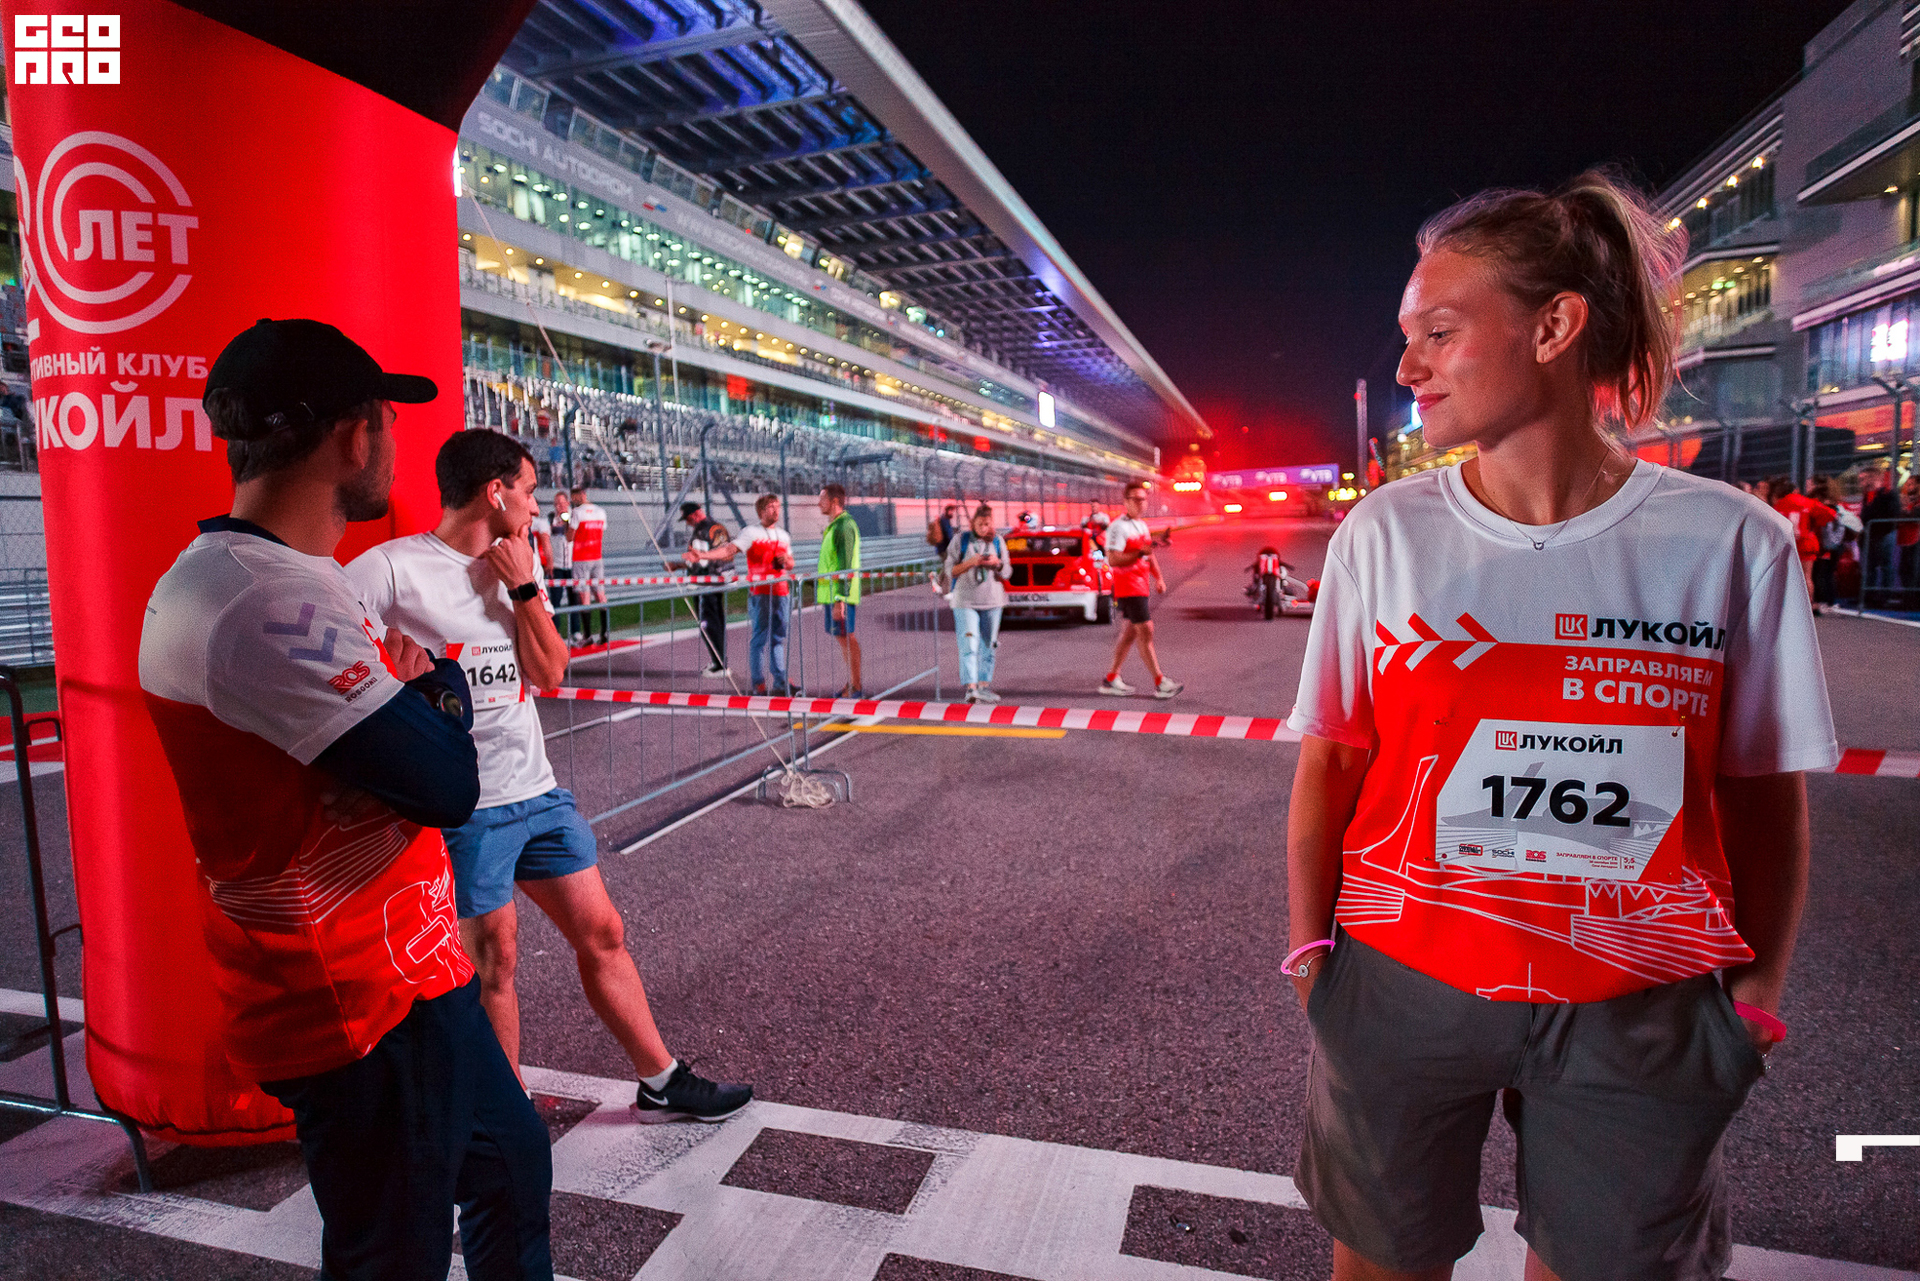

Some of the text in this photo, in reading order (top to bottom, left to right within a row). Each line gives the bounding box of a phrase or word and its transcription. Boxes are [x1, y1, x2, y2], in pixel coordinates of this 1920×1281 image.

[74, 209, 199, 265] ЛЕТ
[31, 346, 209, 382] ТИВНЫЙ КЛУБ
[36, 380, 212, 452] КОЙЛ
[1591, 617, 1726, 652] ЛУКОЙЛ
[327, 660, 371, 695] ROS
[466, 663, 517, 687] 1642
[1565, 655, 1714, 687] ЗАПРАВЛЯЕМ
[1562, 677, 1709, 717] В СПОРТЕ
[1519, 734, 1623, 754] ЛУКОЙЛ
[1482, 774, 1631, 827] 1762
